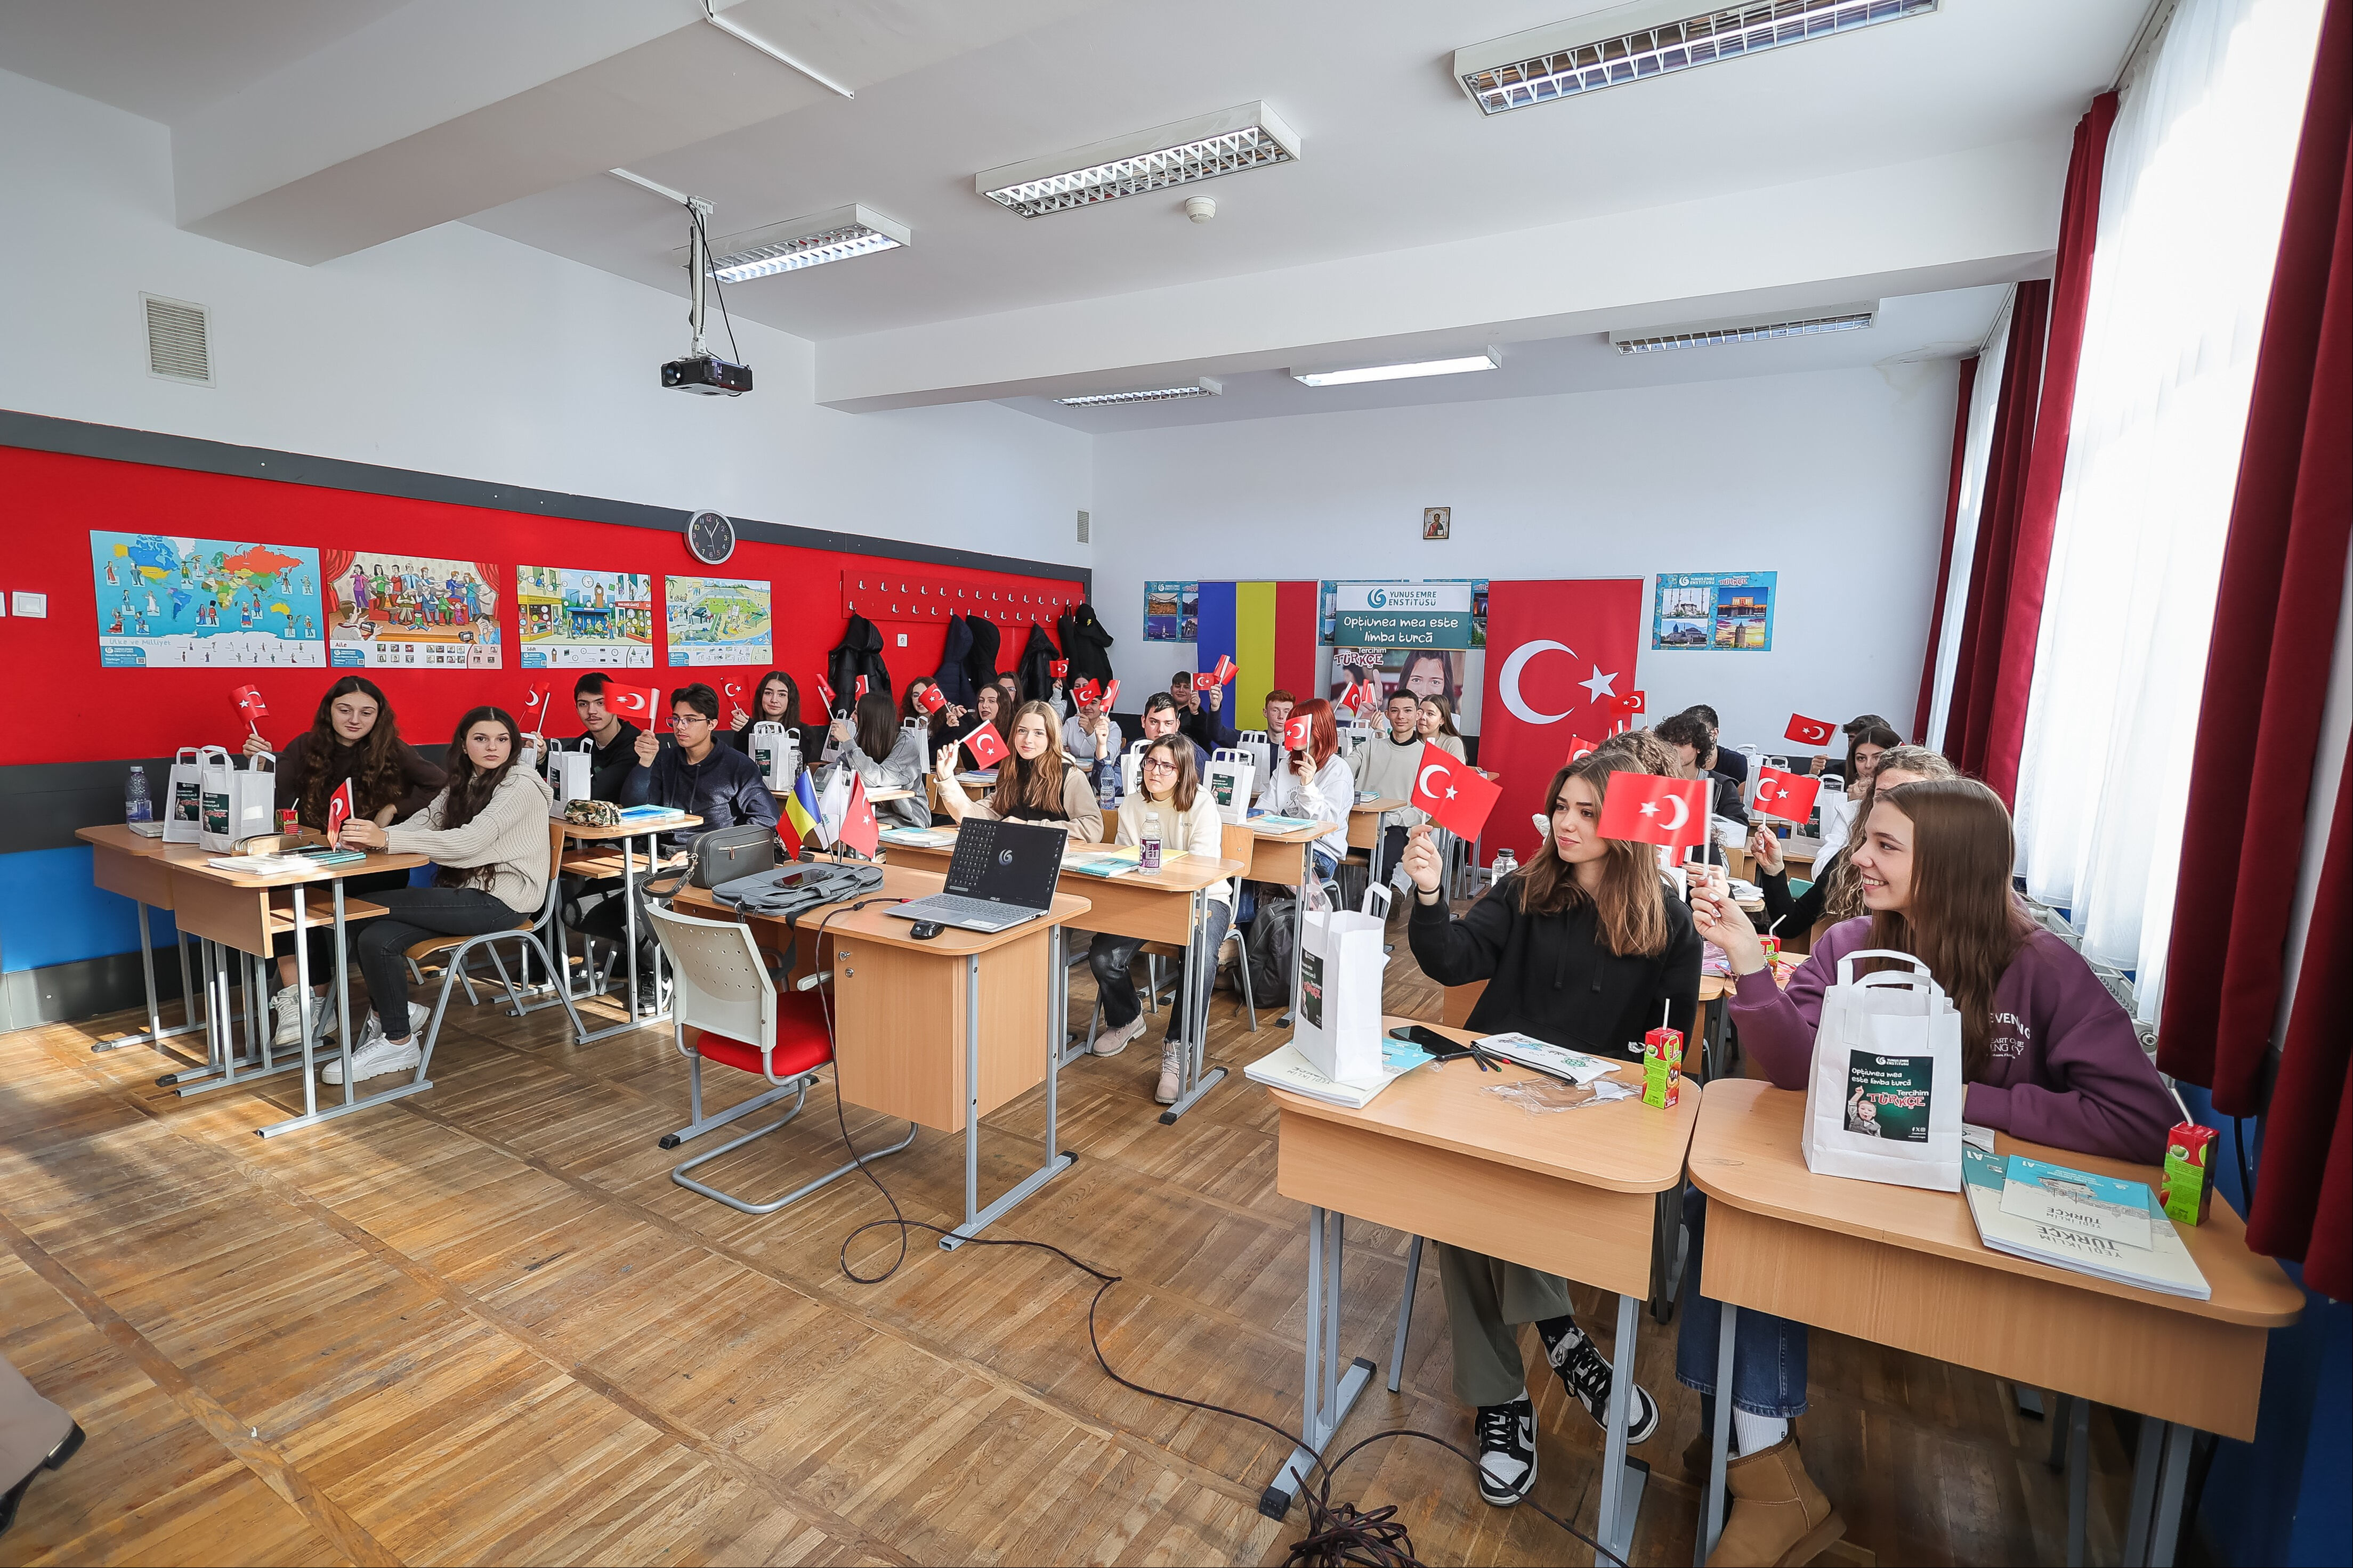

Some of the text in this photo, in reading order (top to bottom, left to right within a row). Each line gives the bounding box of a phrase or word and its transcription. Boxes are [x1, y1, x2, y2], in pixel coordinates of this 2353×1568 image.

[1400, 618, 1426, 627] mea
[1429, 616, 1459, 628] este
[1364, 630, 1433, 643] limba turcă
[1333, 650, 1384, 668] TÜRKÇE
[1866, 1092, 1926, 1109] TÜRKÇE
[1967, 1150, 1983, 1161] A1
[2046, 1206, 2101, 1225] TÜRKÇE
[2035, 1225, 2120, 1251] TÜRKÇE
